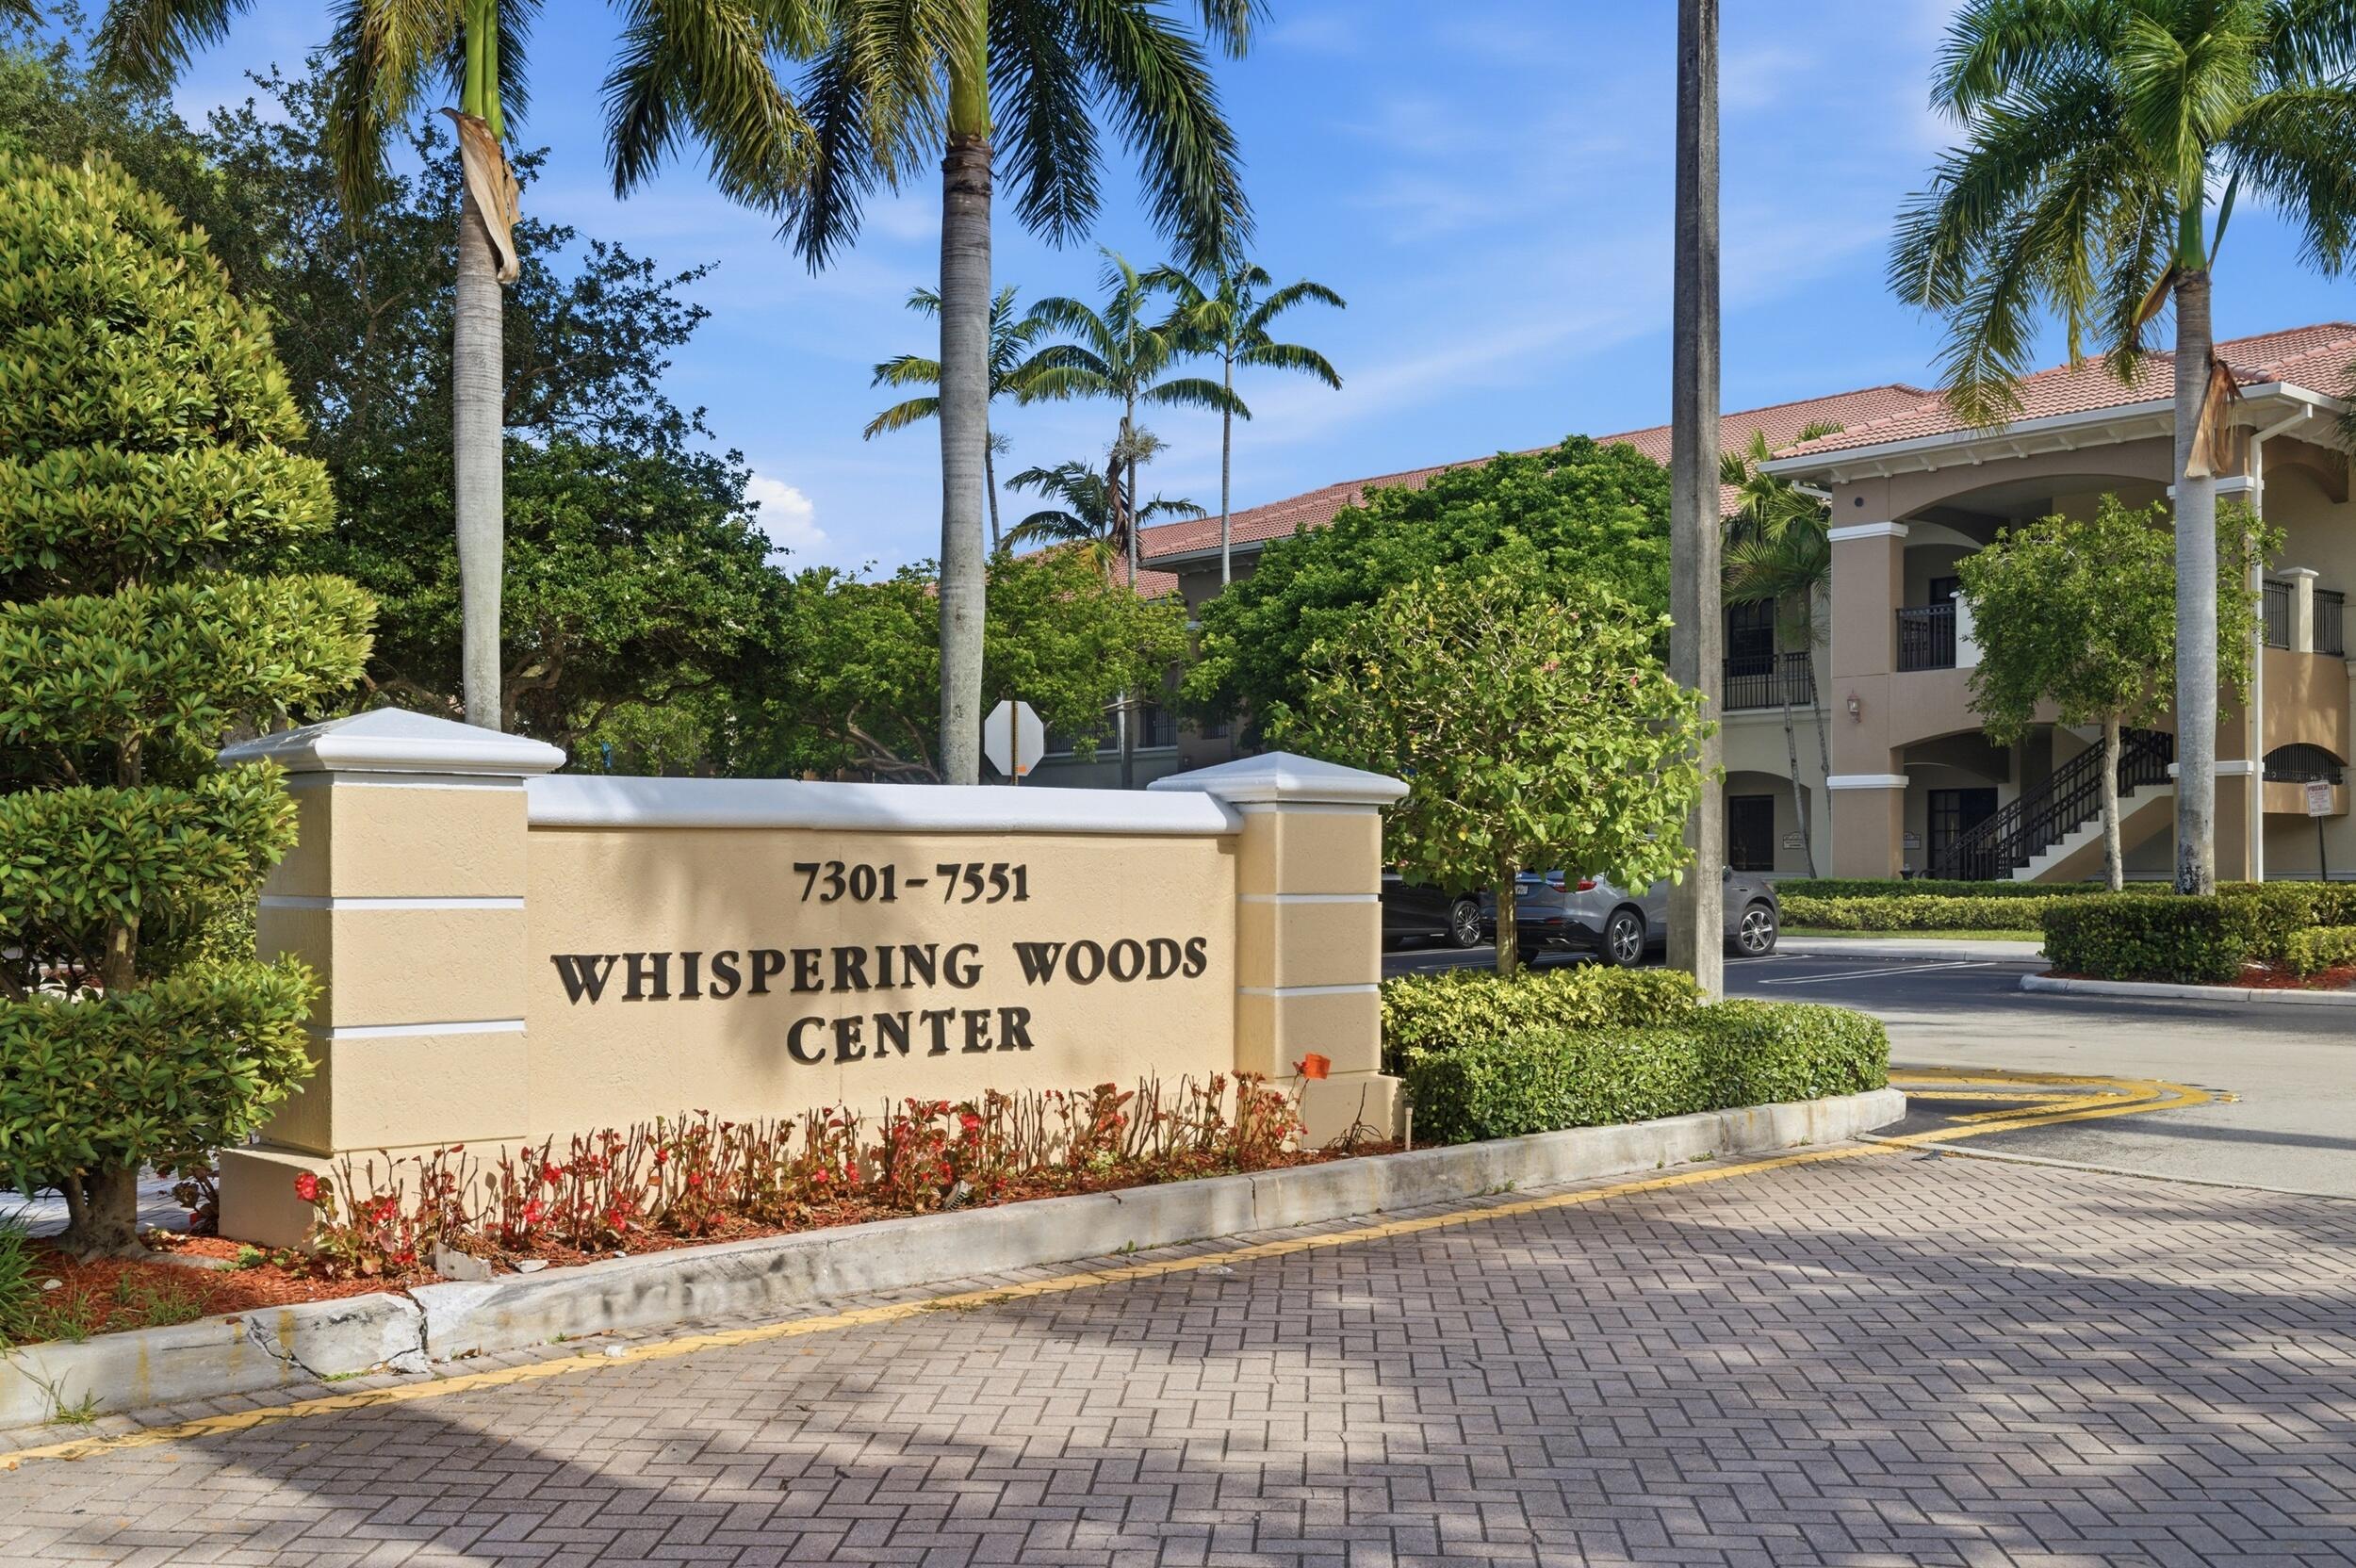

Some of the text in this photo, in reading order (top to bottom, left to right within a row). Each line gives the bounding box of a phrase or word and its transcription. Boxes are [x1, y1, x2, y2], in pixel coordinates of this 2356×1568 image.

[794, 862, 1030, 902] 7301-7551
[551, 938, 1207, 1003] WHISPERING WOODS
[787, 1007, 1035, 1062] CENTER
